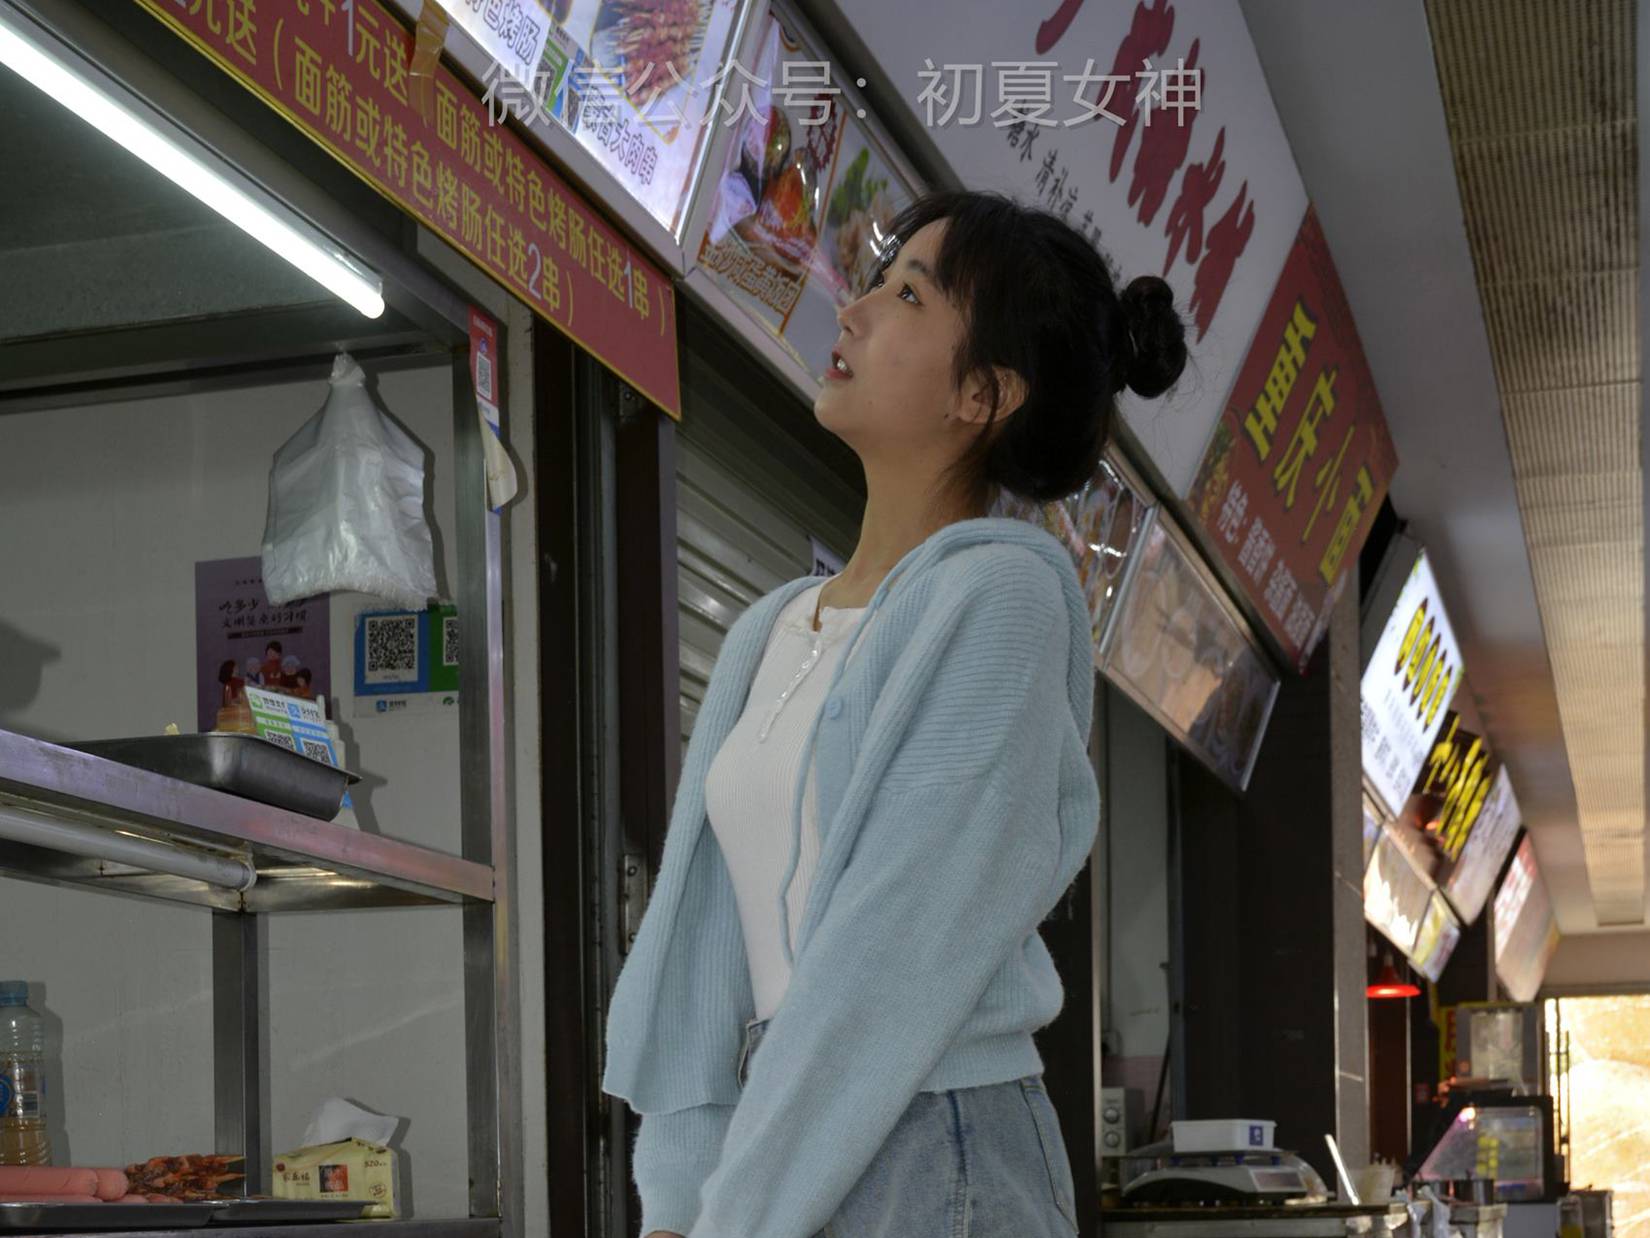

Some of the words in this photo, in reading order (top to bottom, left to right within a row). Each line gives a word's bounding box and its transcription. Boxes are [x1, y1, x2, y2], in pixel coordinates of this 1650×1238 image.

[465, 0, 541, 66] 色烤肠
[1244, 299, 1374, 587] 重庆小面
